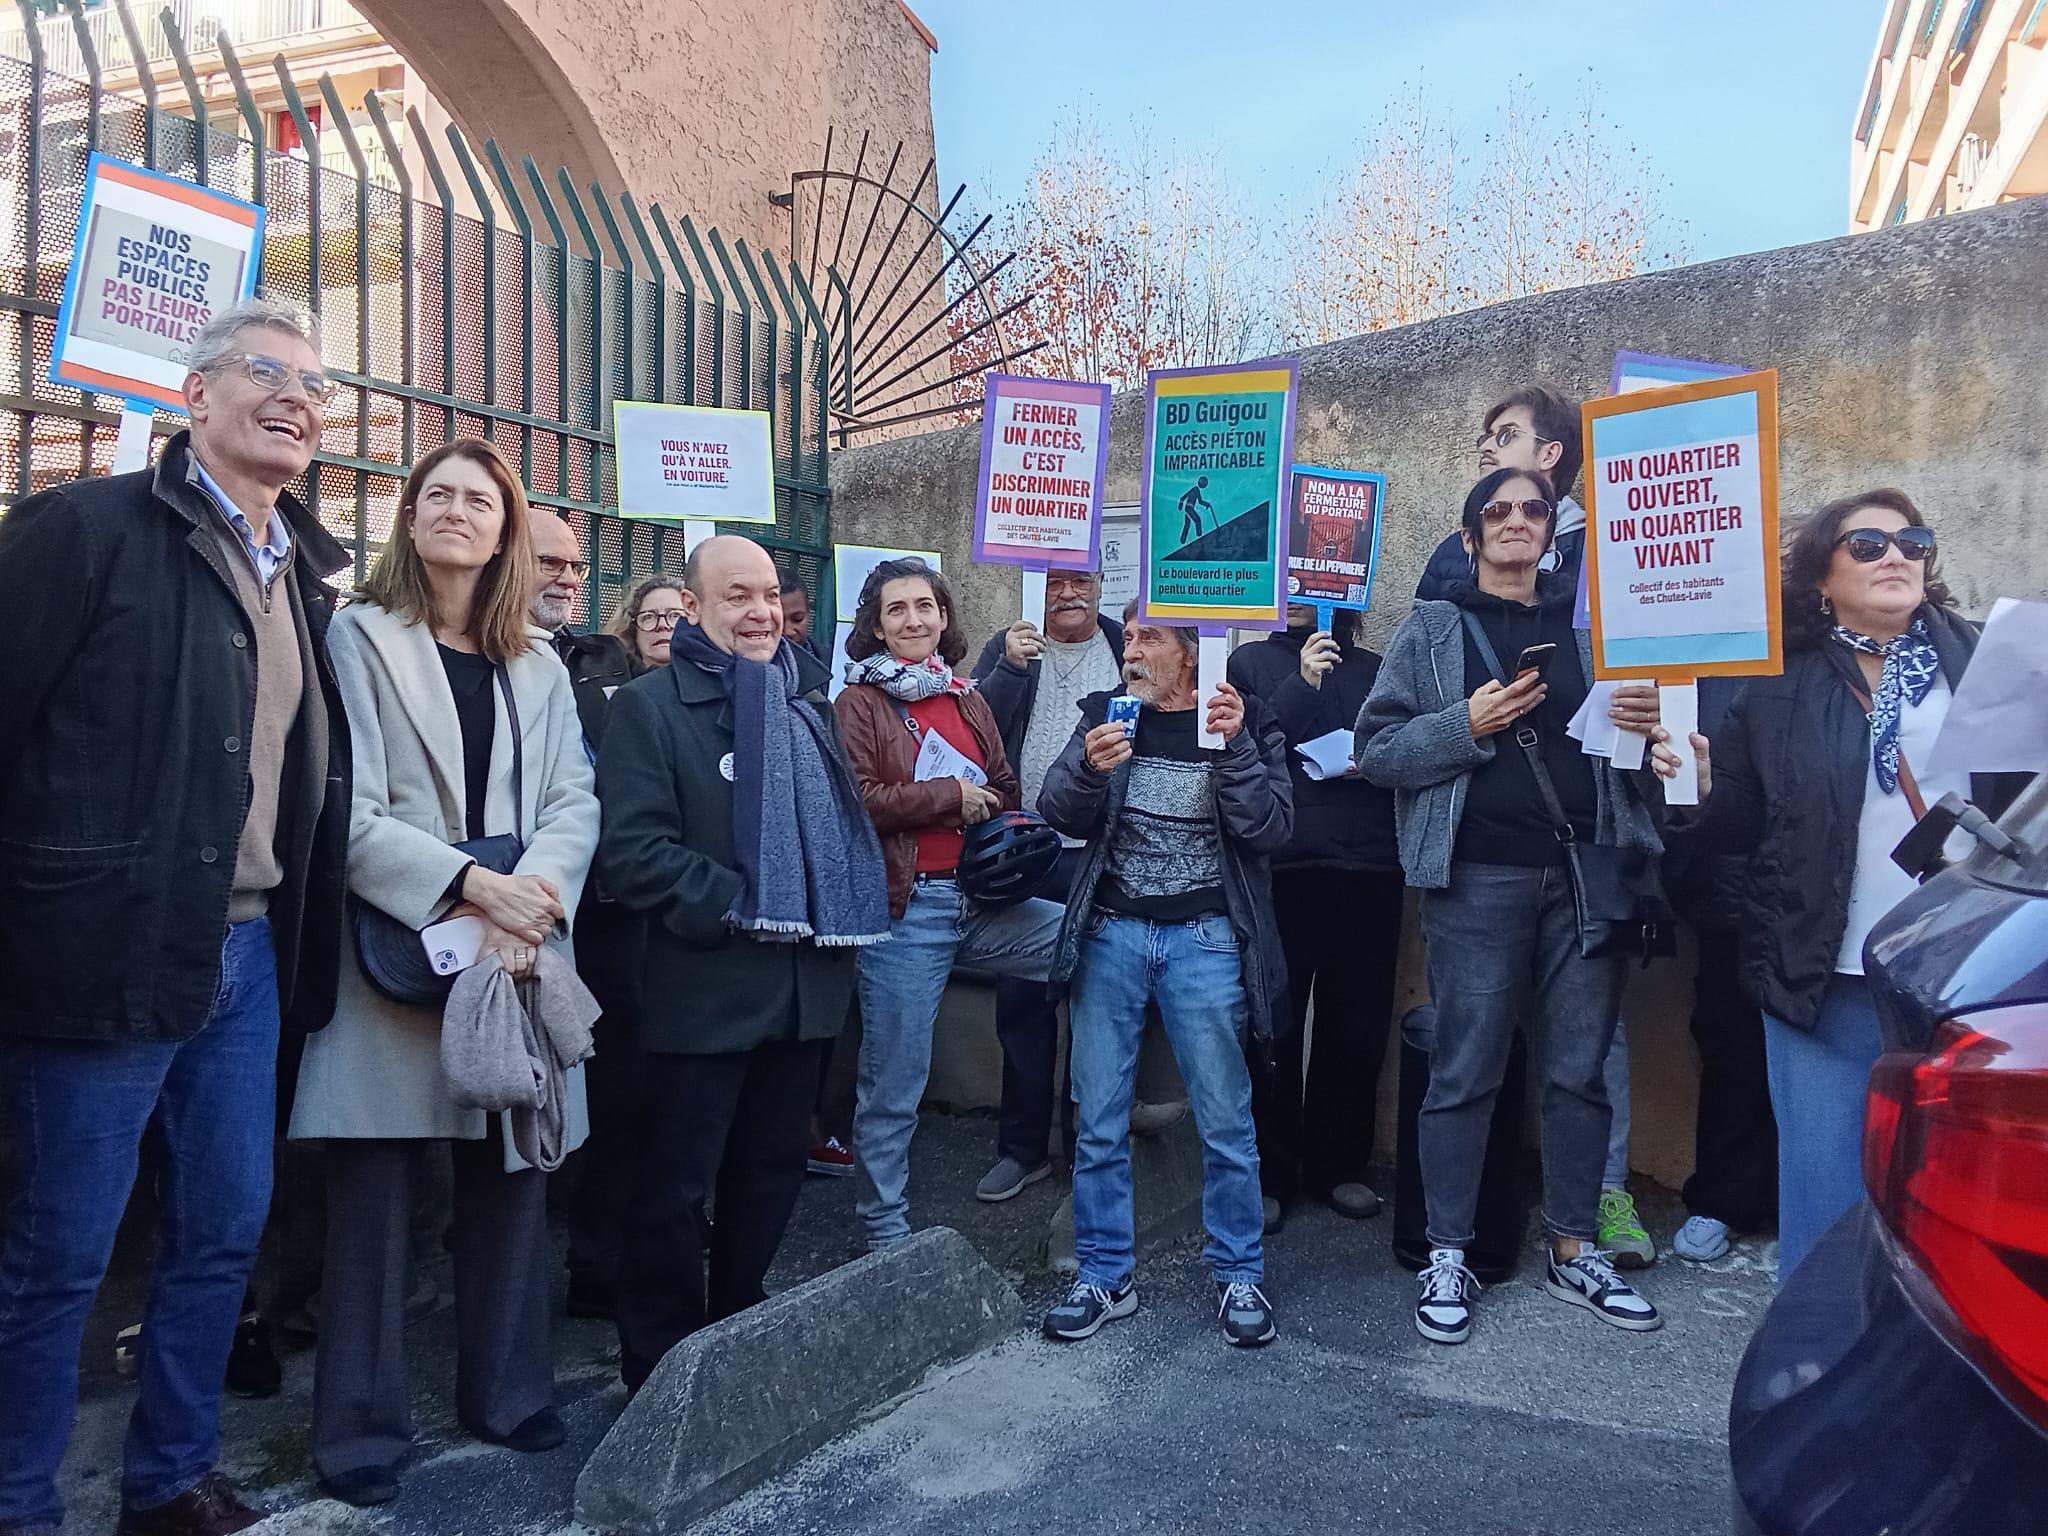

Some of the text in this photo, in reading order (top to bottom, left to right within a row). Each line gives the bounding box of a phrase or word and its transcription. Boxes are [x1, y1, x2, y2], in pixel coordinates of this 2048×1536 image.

[150, 224, 191, 253] NOS
[118, 237, 210, 283] ESPACES
[118, 260, 208, 306] PUBLICS,
[102, 279, 212, 326] PAS LEURS
[102, 302, 199, 344] PORTAILS
[1012, 403, 1077, 426] FERMER
[1166, 401, 1267, 426] BD Guigou
[661, 440, 728, 455] VOUS N'AVEZ
[1004, 427, 1086, 453] UN ACCÈS,
[1165, 429, 1265, 451] ACCÈS PIÉTON
[661, 454, 686, 467] QU'À
[689, 457, 695, 466] Y
[1023, 452, 1065, 473] C'EST
[1164, 451, 1265, 471] IMPRATICABLE
[1607, 443, 1741, 484] UN QUARTIER
[664, 469, 729, 483] EN VOITURE.
[992, 473, 1090, 498] DISCRIMINER
[1308, 480, 1335, 495] NON
[1349, 485, 1365, 498] LA
[1628, 477, 1719, 511] OUVERT,
[992, 496, 1087, 521] UN QUARTIER
[1304, 492, 1367, 510] FERMETURE
[1305, 504, 1363, 520] DU PORTAIL
[1609, 505, 1742, 543] UN QUARTIER
[1288, 556, 1304, 570] RUE
[1304, 557, 1316, 571] DE
[1316, 559, 1326, 572] LA
[1634, 538, 1714, 570] VIVANT
[1159, 567, 1258, 585] Le boulevard le plus
[1629, 576, 1725, 593] Collectif des habitants
[1158, 583, 1246, 598] pentu du quartier
[1639, 589, 1713, 604] des Chutes-Lavie
